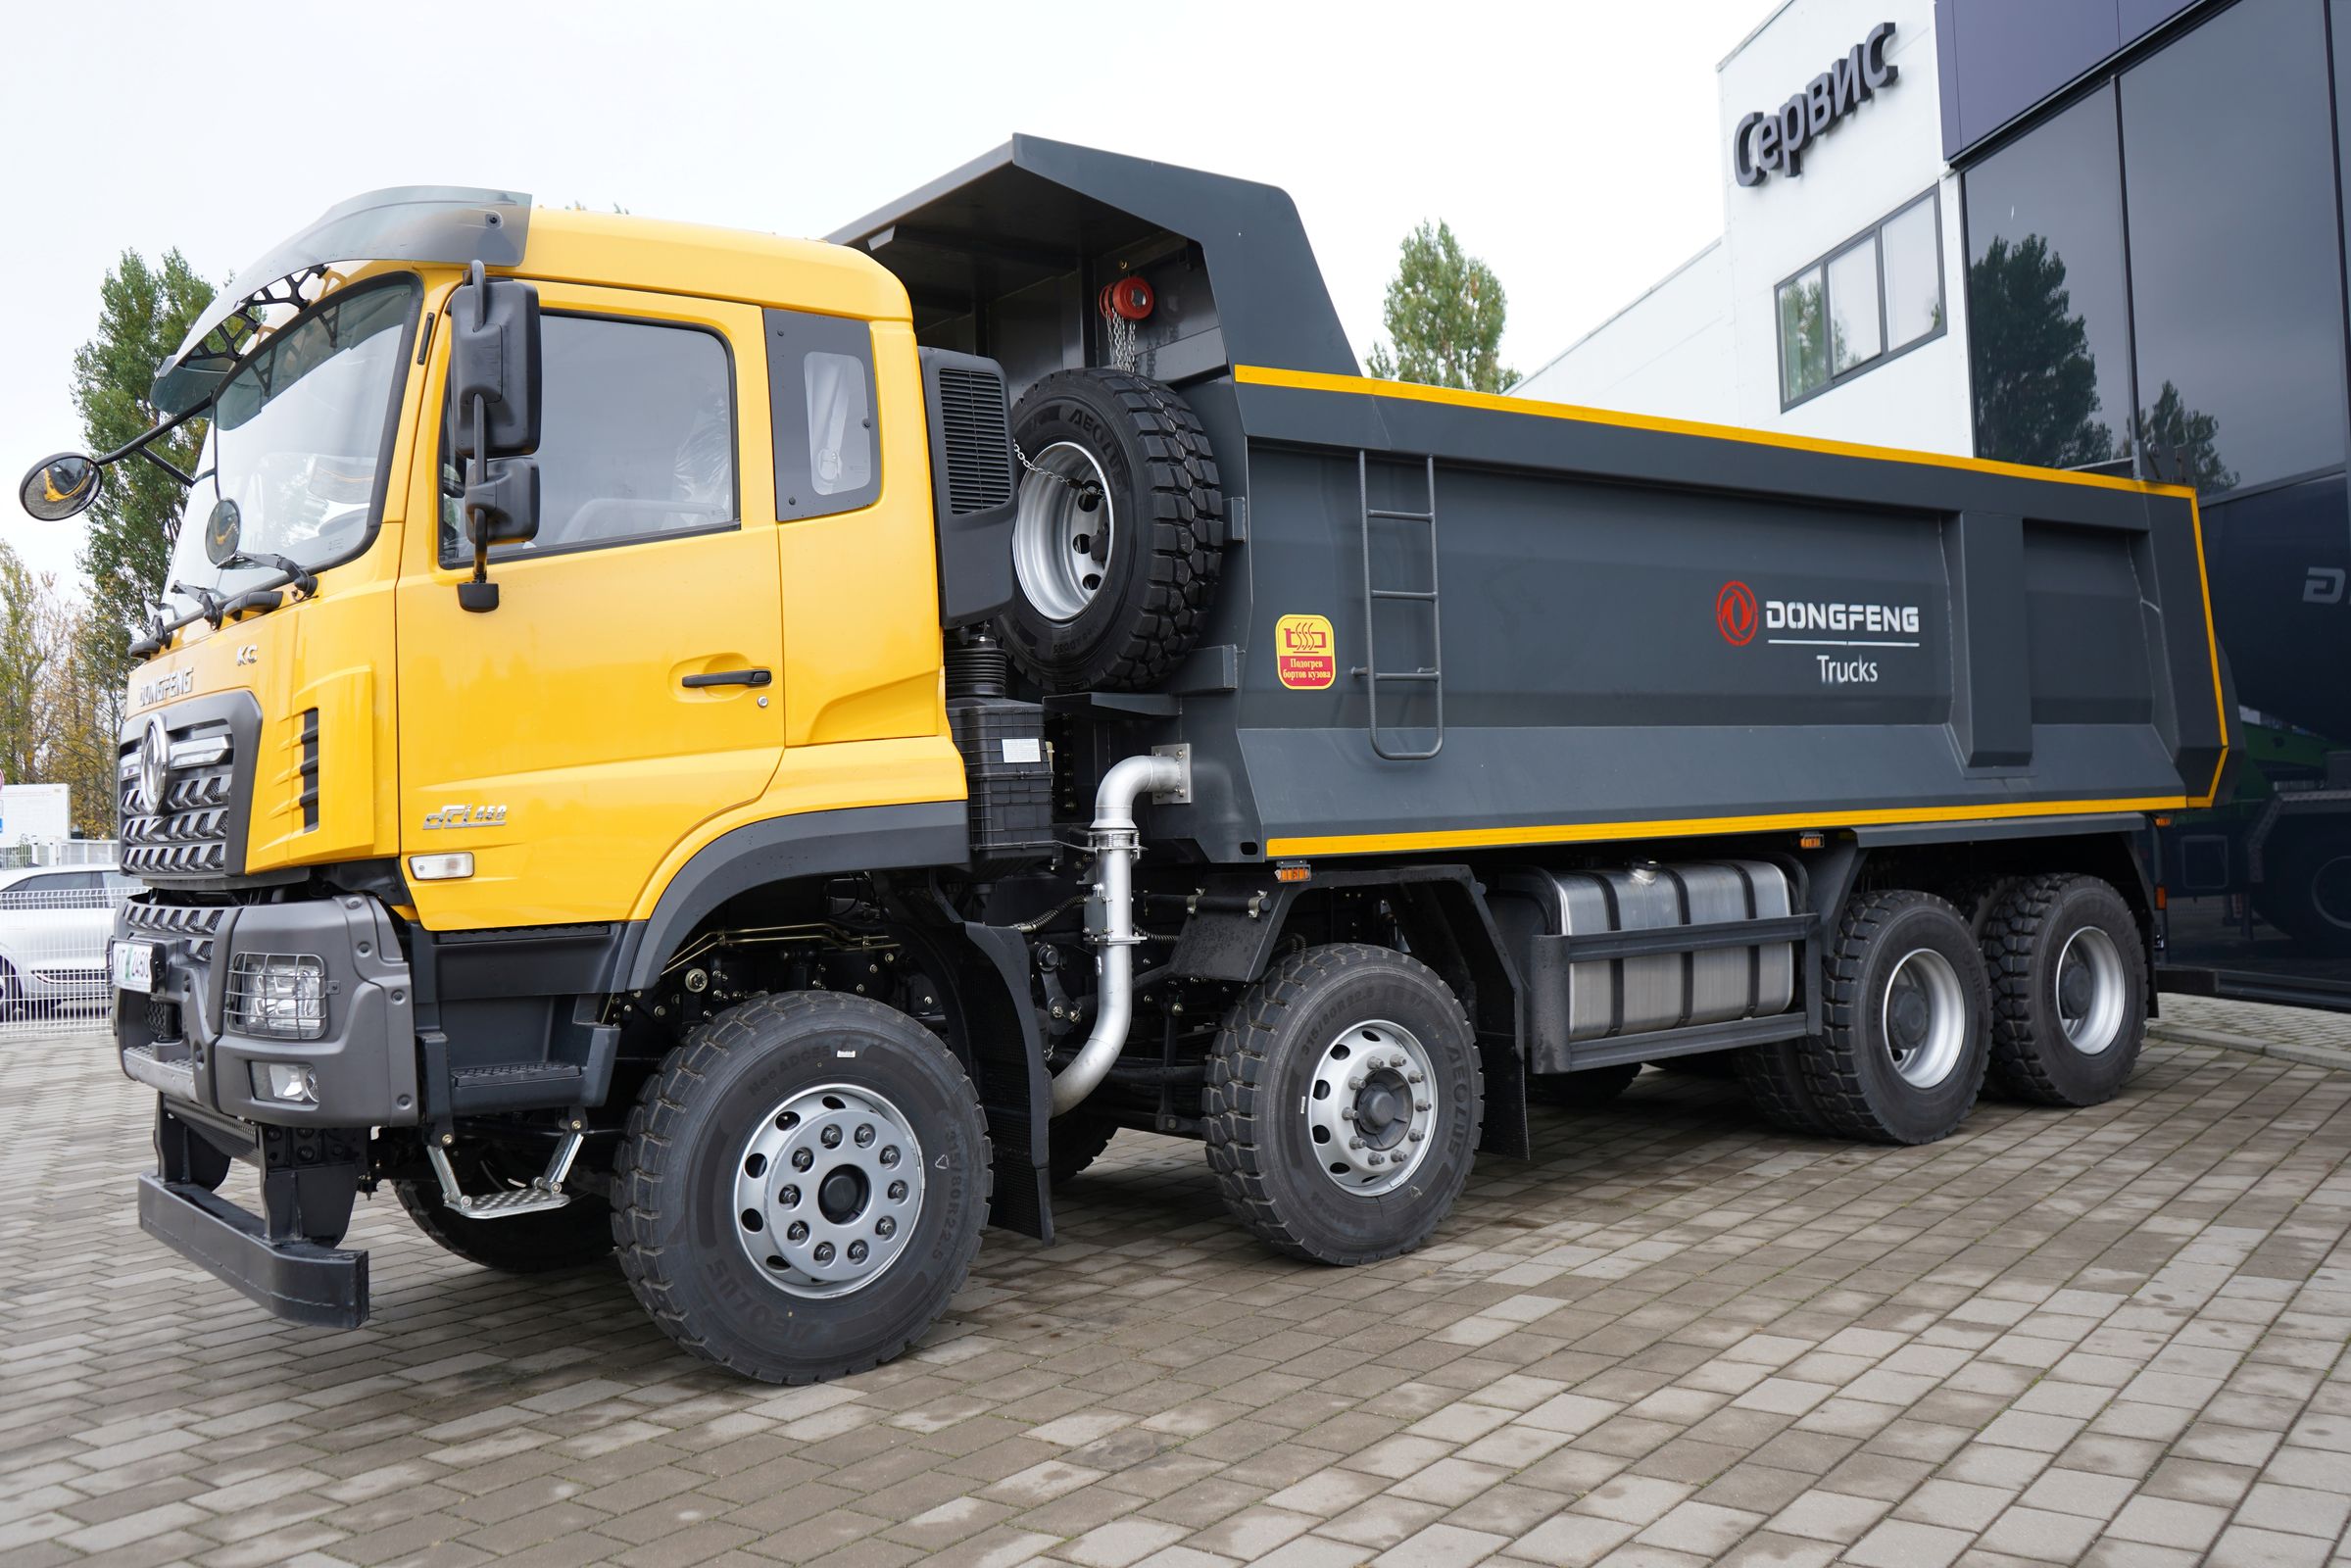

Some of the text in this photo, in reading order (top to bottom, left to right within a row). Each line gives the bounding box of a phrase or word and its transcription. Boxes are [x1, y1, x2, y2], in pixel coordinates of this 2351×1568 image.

[1734, 22, 1898, 187] Сервис
[1766, 601, 1920, 633] DONGFENG
[236, 644, 258, 666] KC
[1290, 658, 1323, 670] Подогрев
[1816, 654, 1879, 683] Trucks
[1283, 668, 1331, 680] бортов кузова
[1445, 1046, 1469, 1158] AEOLUS
